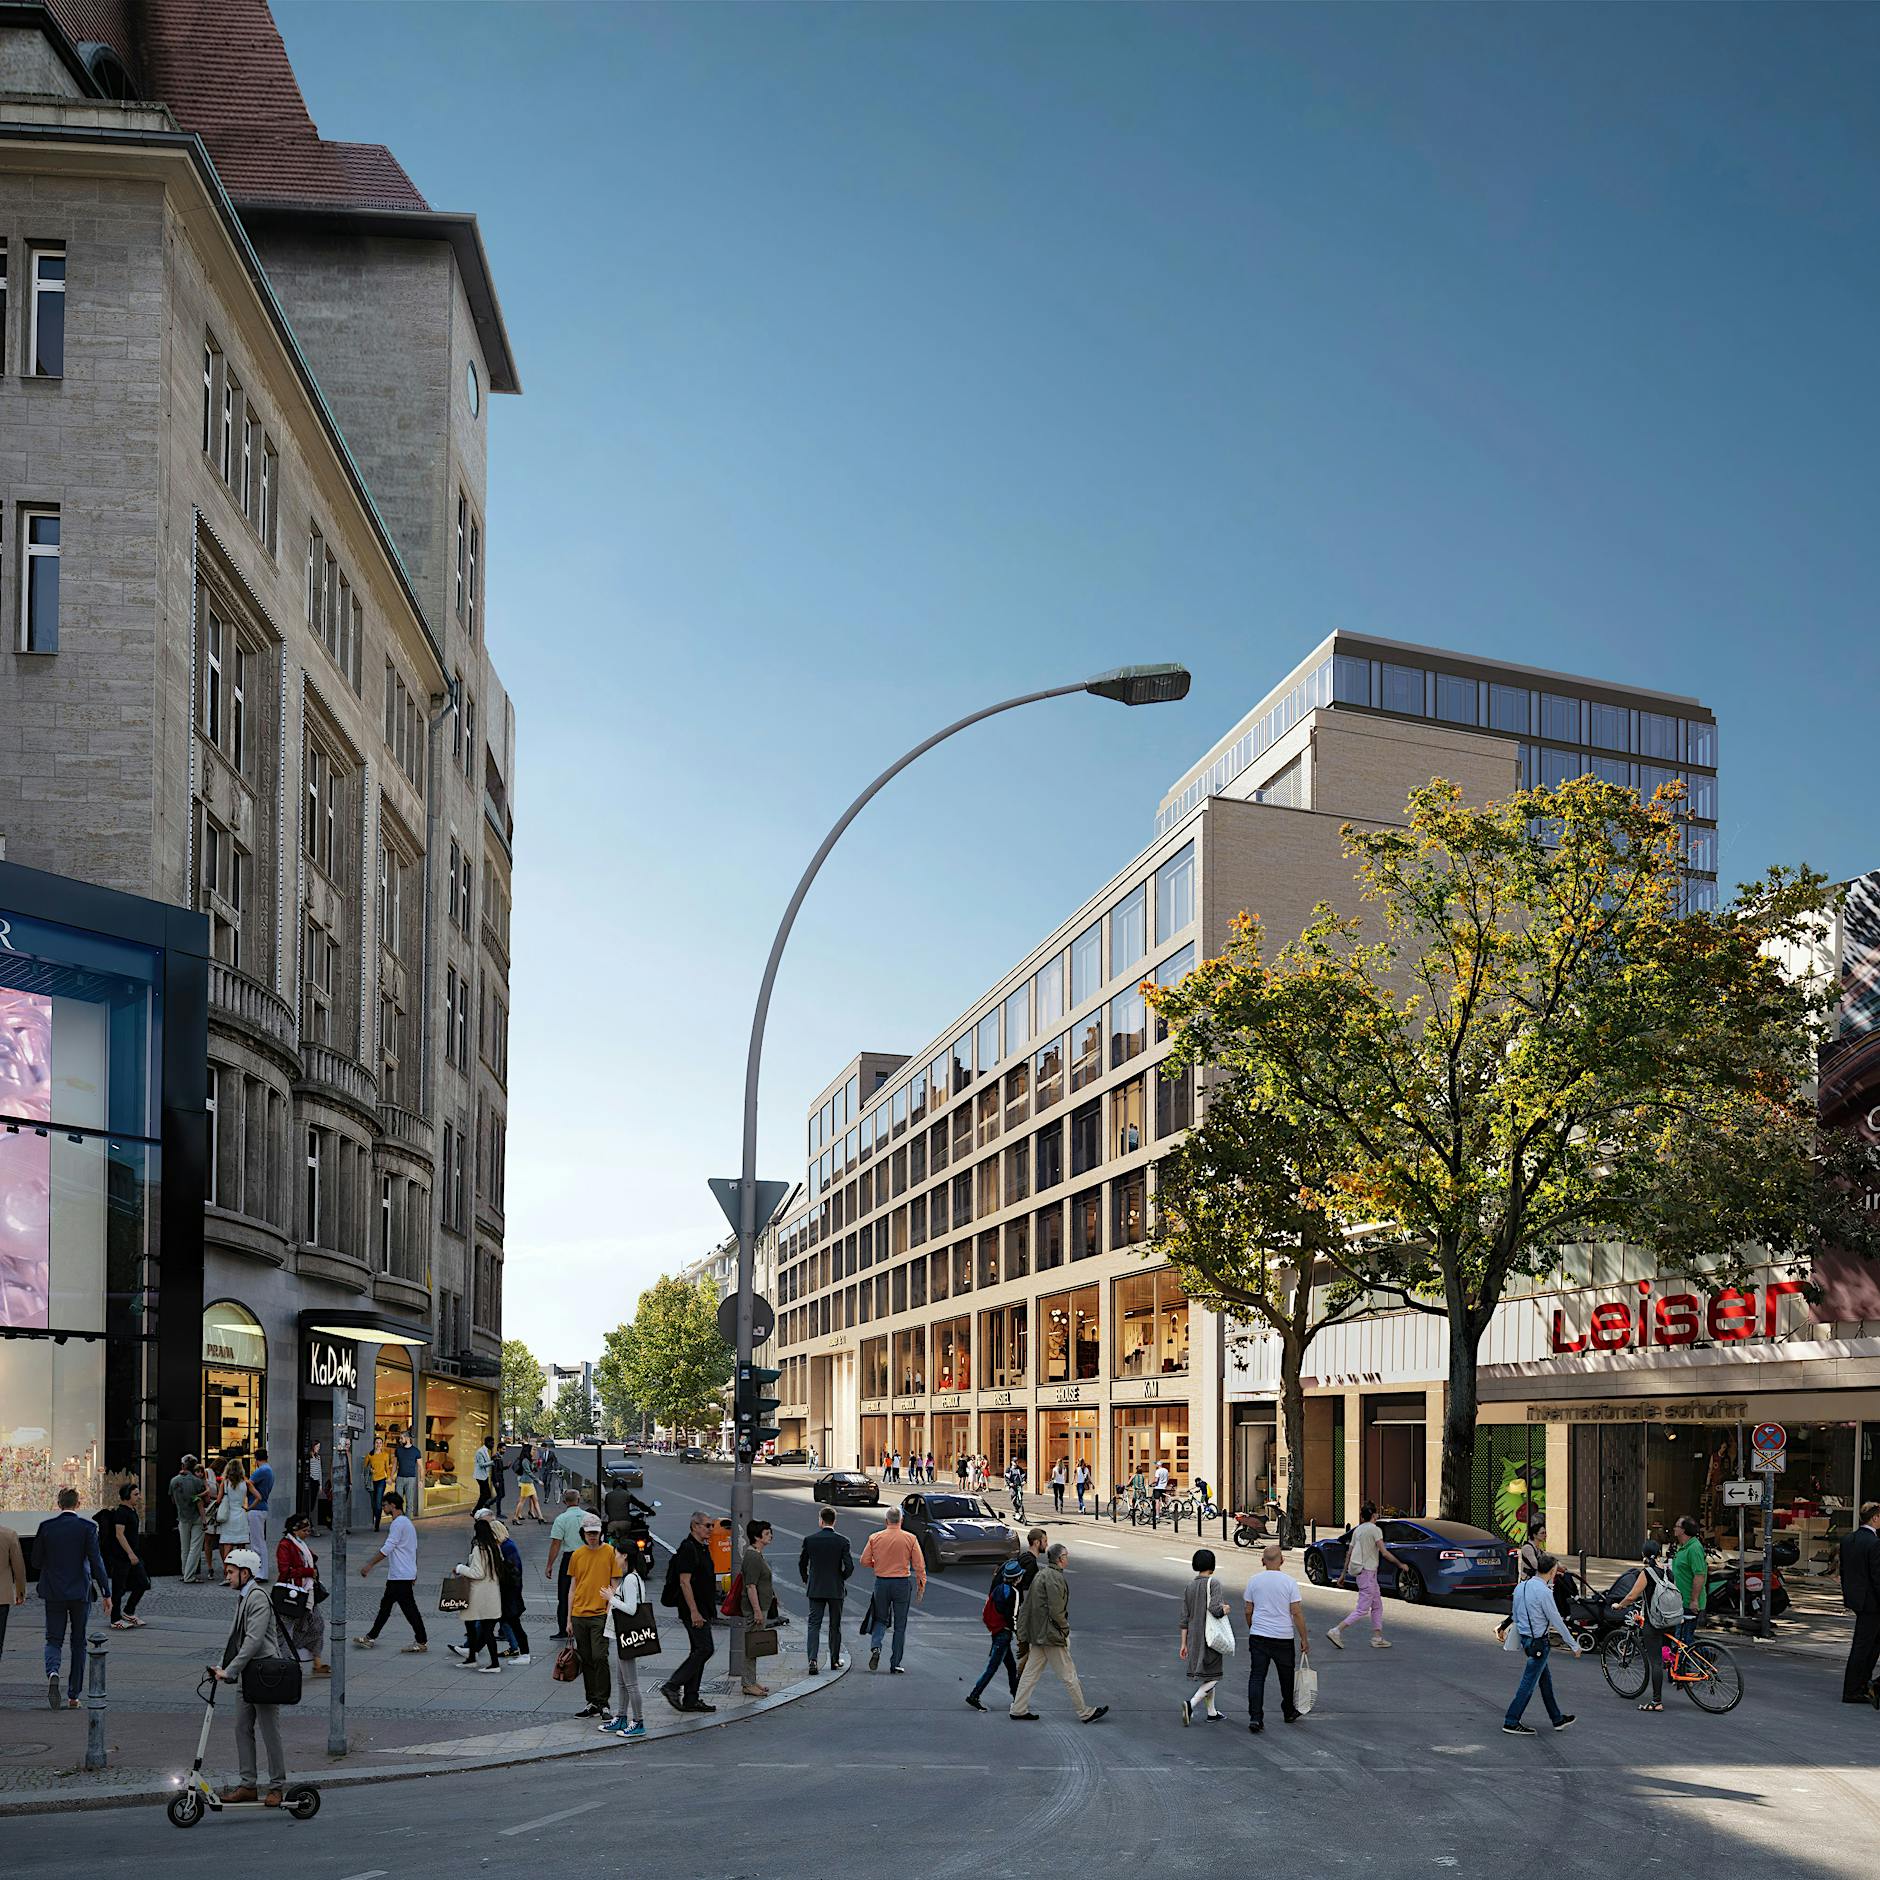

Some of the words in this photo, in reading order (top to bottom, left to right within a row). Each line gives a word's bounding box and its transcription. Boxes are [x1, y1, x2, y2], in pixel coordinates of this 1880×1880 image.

[1552, 1280, 1812, 1354] Leiser
[311, 1342, 357, 1389] KaDeWe
[441, 1599, 468, 1609] KaDeWe
[620, 1628, 656, 1648] KaDeWe
